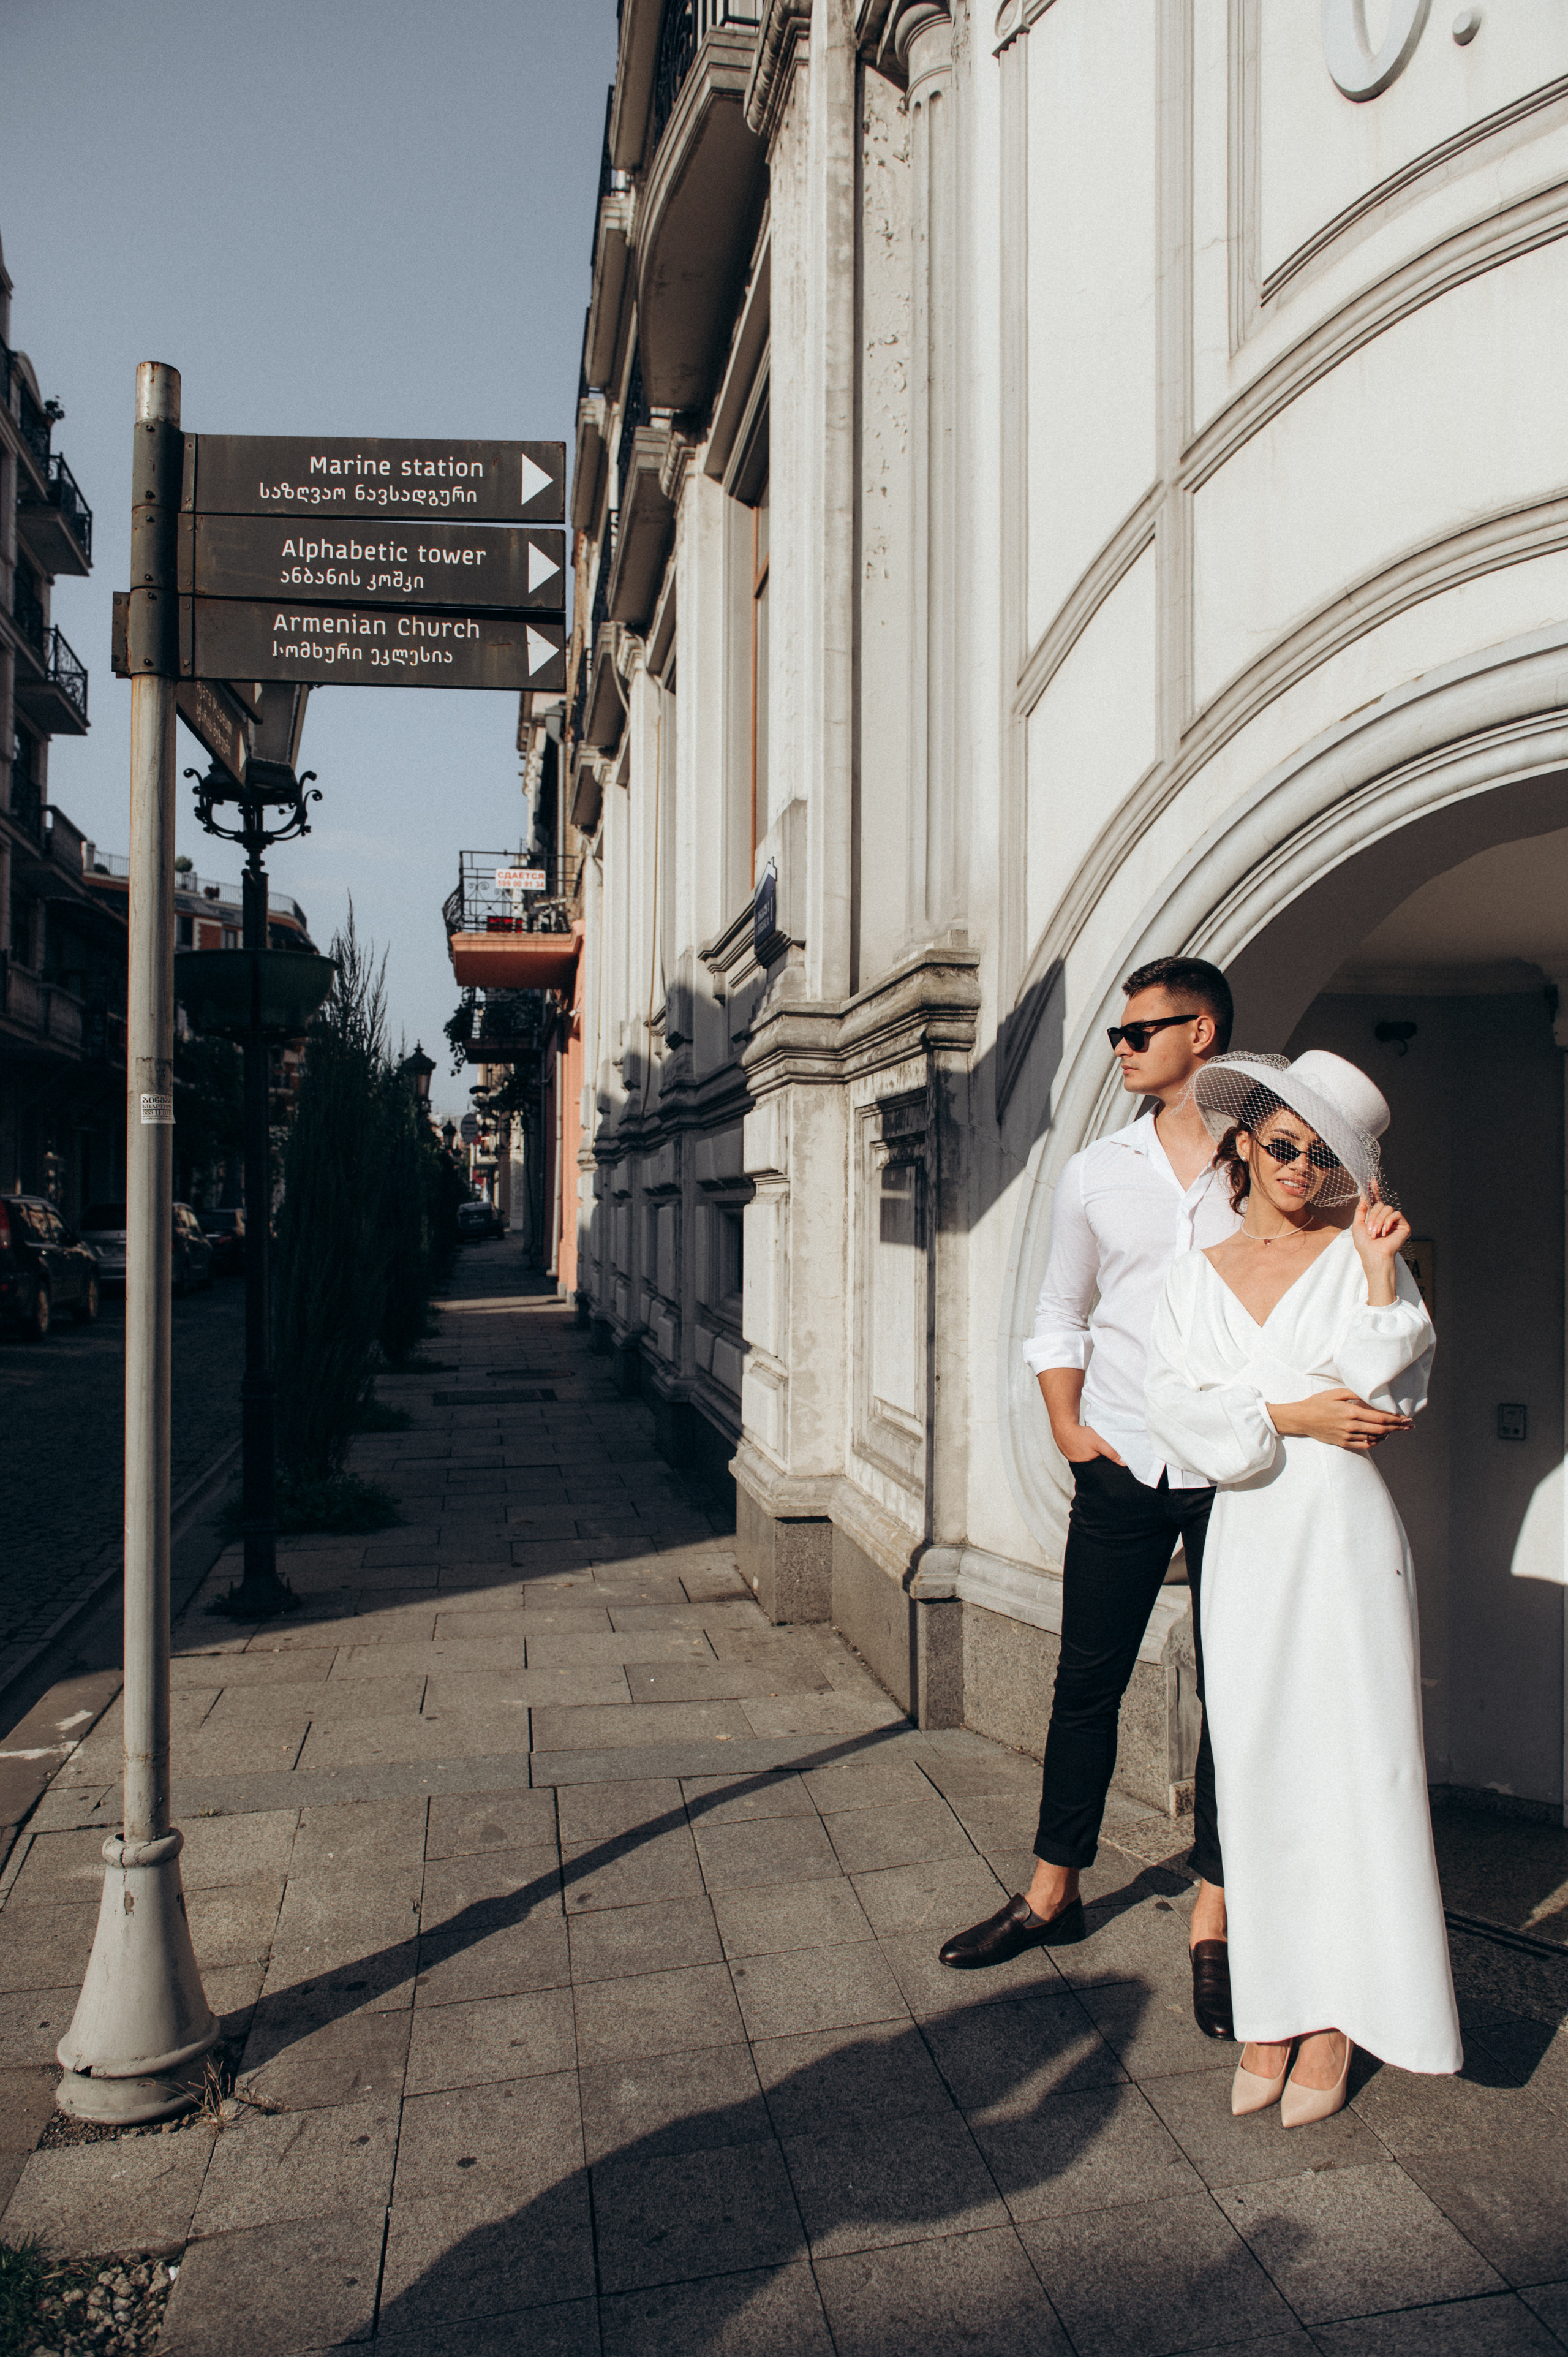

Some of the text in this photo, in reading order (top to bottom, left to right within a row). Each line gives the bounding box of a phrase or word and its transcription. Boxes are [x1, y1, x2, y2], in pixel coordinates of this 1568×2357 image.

[310, 454, 483, 477] Marine station
[260, 482, 477, 507] საზღვაო ნავსადგური
[281, 537, 486, 565] Alphabetic tower
[280, 567, 424, 592] ანბანის კოშკი
[273, 613, 480, 638] Armenian Church
[371, 646, 453, 666] ეკლესია
